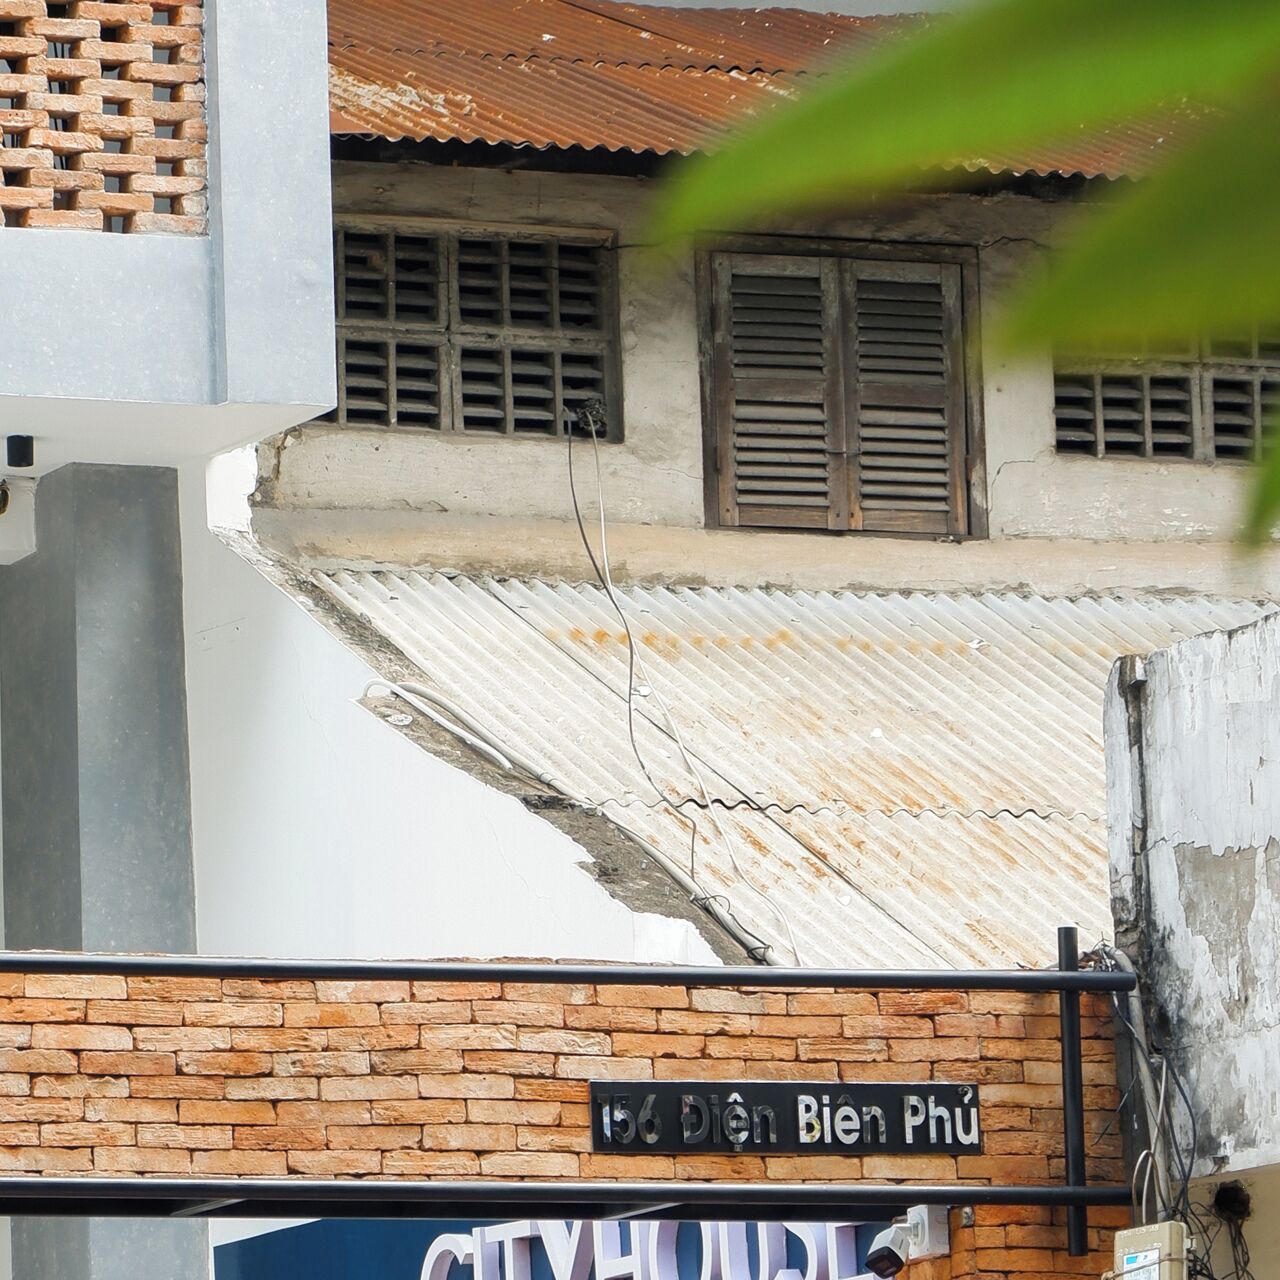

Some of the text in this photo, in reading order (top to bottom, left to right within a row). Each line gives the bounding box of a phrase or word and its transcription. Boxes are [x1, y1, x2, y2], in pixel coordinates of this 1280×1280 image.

[596, 1085, 979, 1152] 156 Điện Biên Phủ
